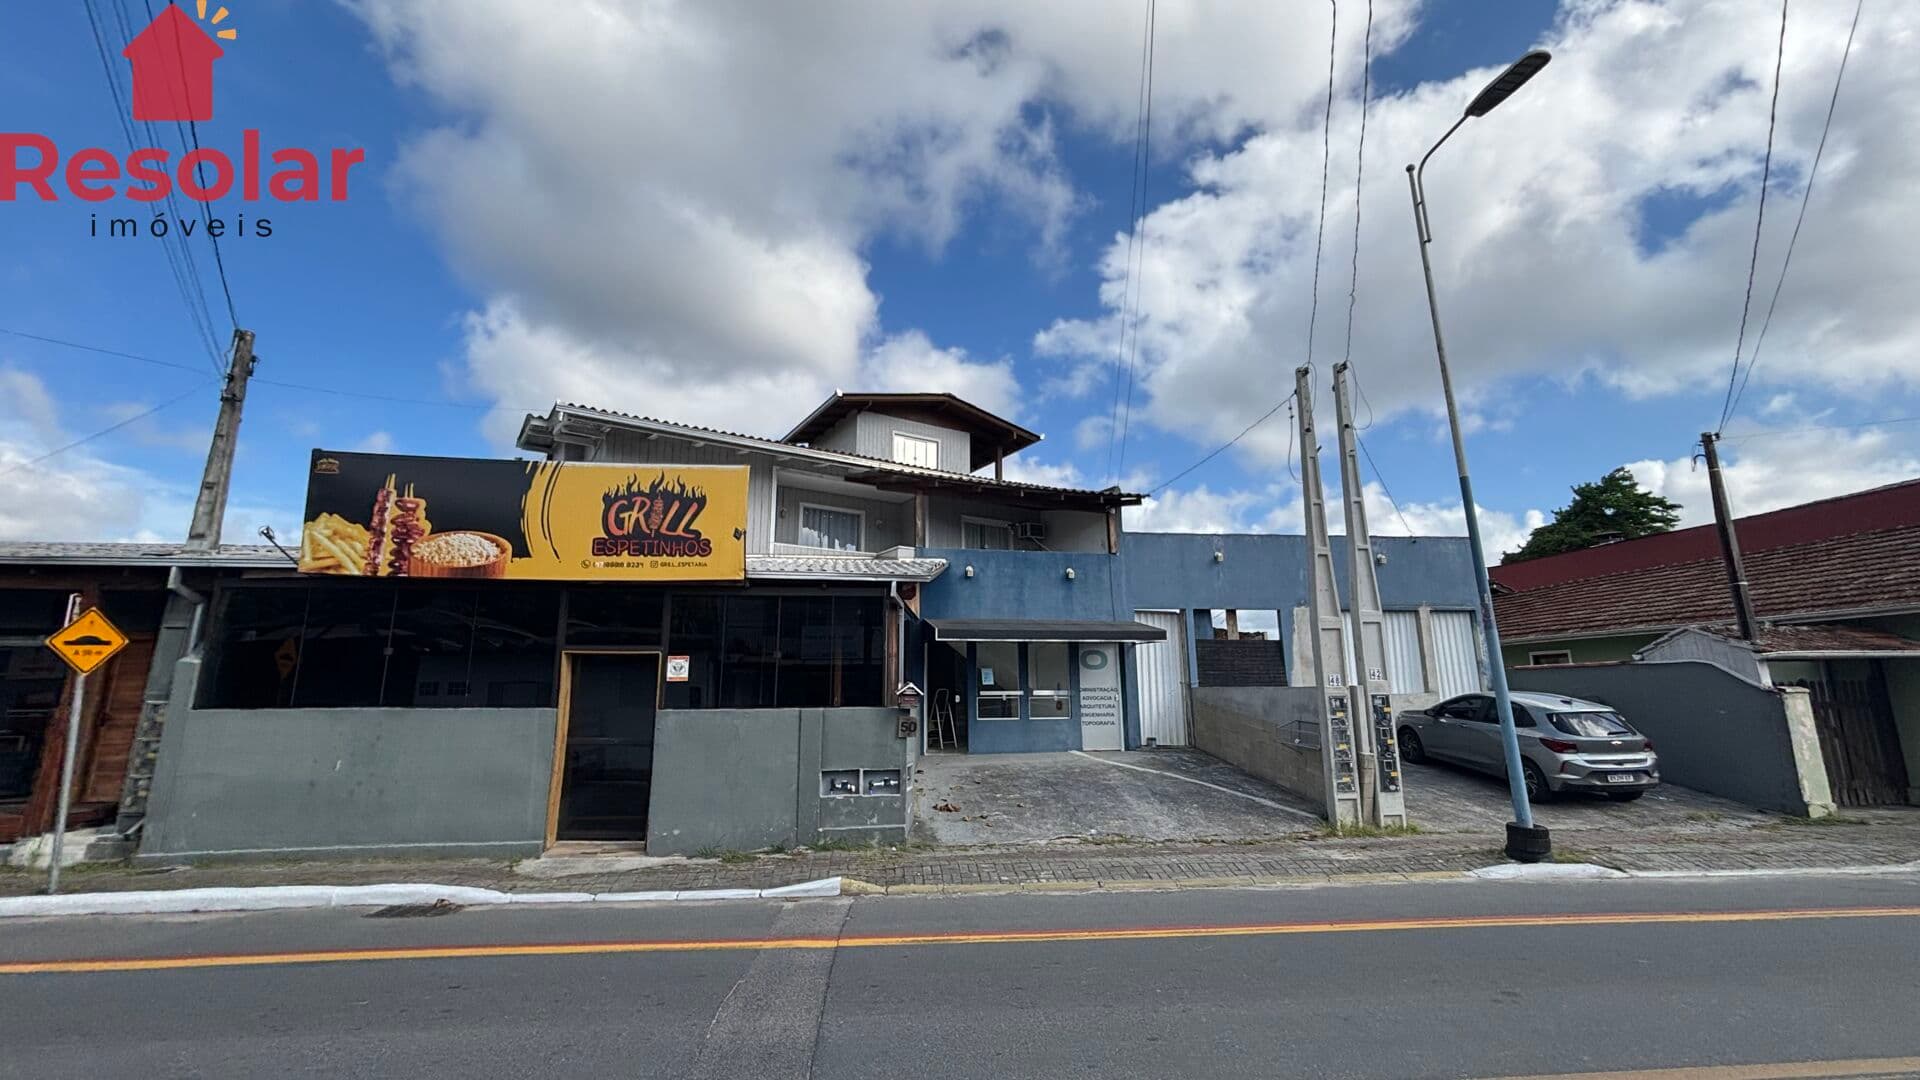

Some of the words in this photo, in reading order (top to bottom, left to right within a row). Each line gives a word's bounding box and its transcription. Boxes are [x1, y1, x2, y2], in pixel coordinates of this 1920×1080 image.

[607, 496, 698, 537] GRILL
[593, 538, 711, 556] ESPETINHOS
[901, 721, 917, 733] 50
